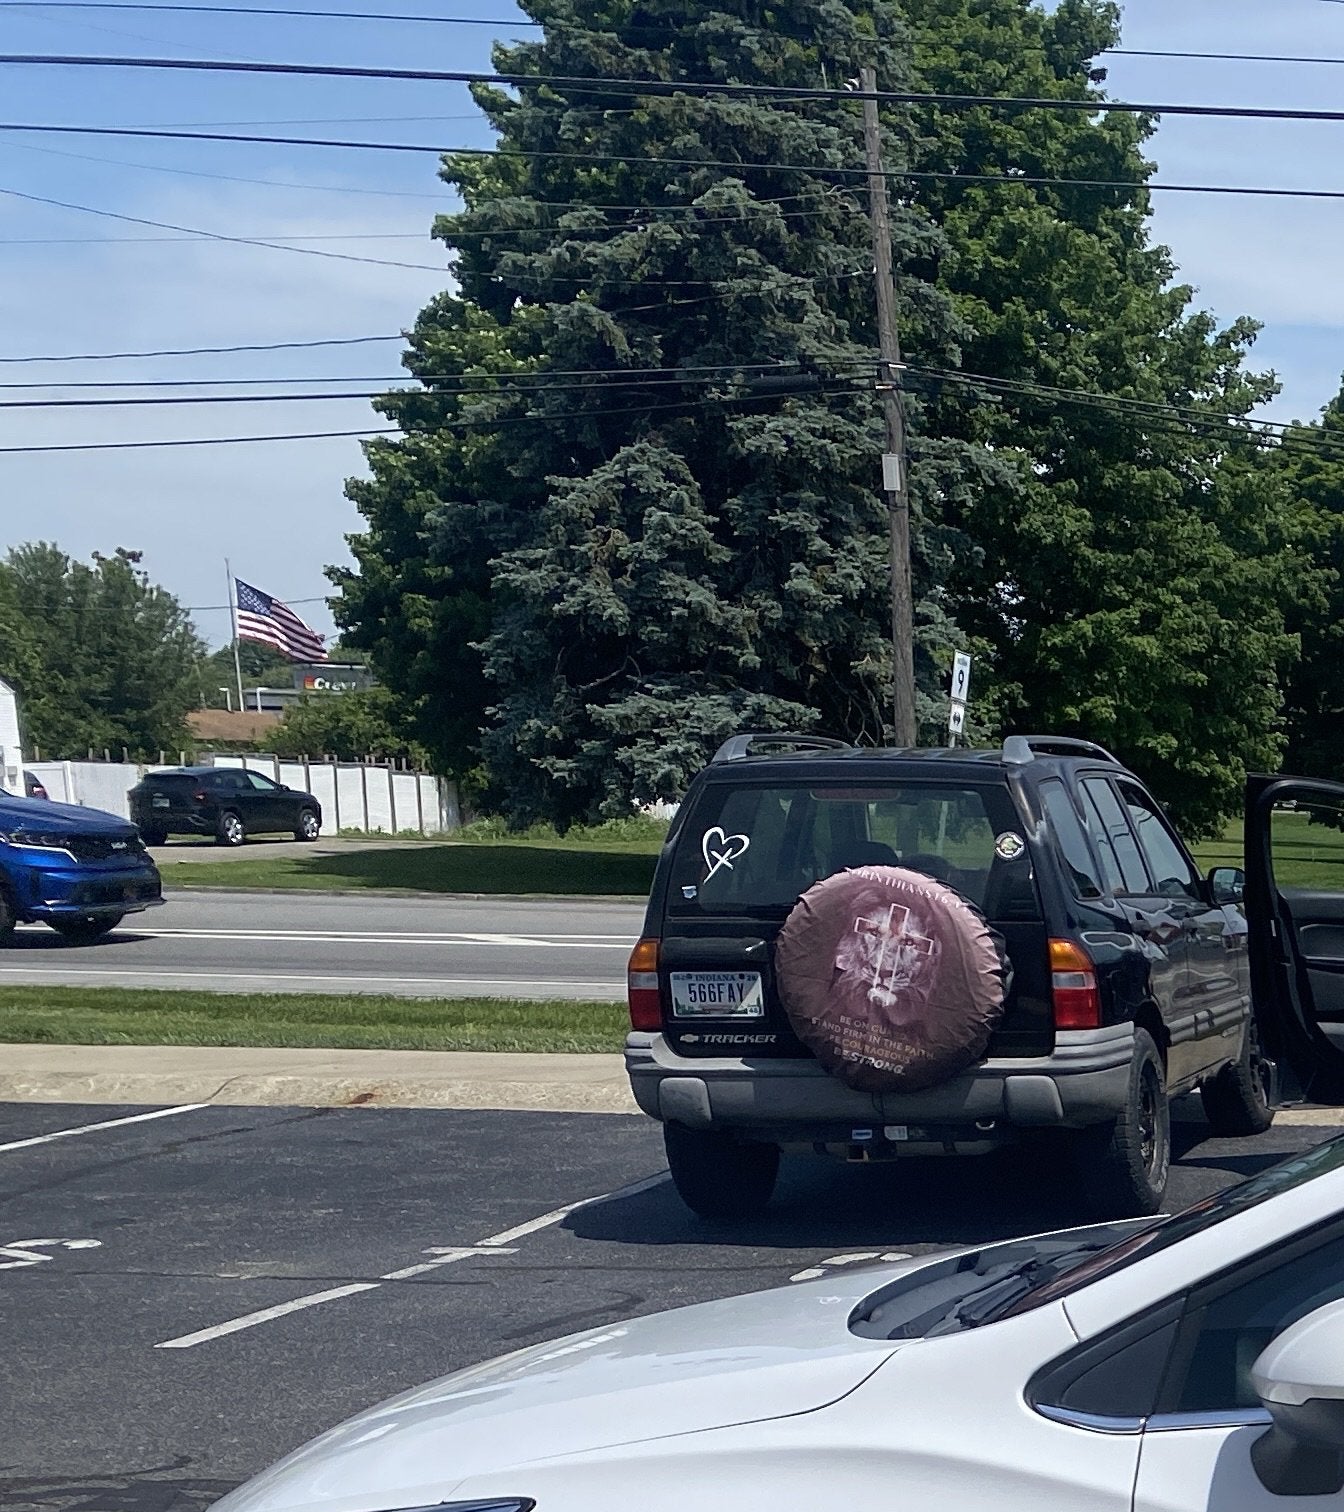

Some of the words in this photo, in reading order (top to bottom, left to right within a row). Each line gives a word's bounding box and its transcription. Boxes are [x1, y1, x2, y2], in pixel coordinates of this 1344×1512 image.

[695, 973, 736, 982] INDIANA
[688, 983, 744, 1003] 566FAY
[840, 1015, 851, 1025] BE
[702, 1034, 776, 1044] TRACKER
[868, 1034, 881, 1045] IN
[884, 1038, 902, 1051] THE
